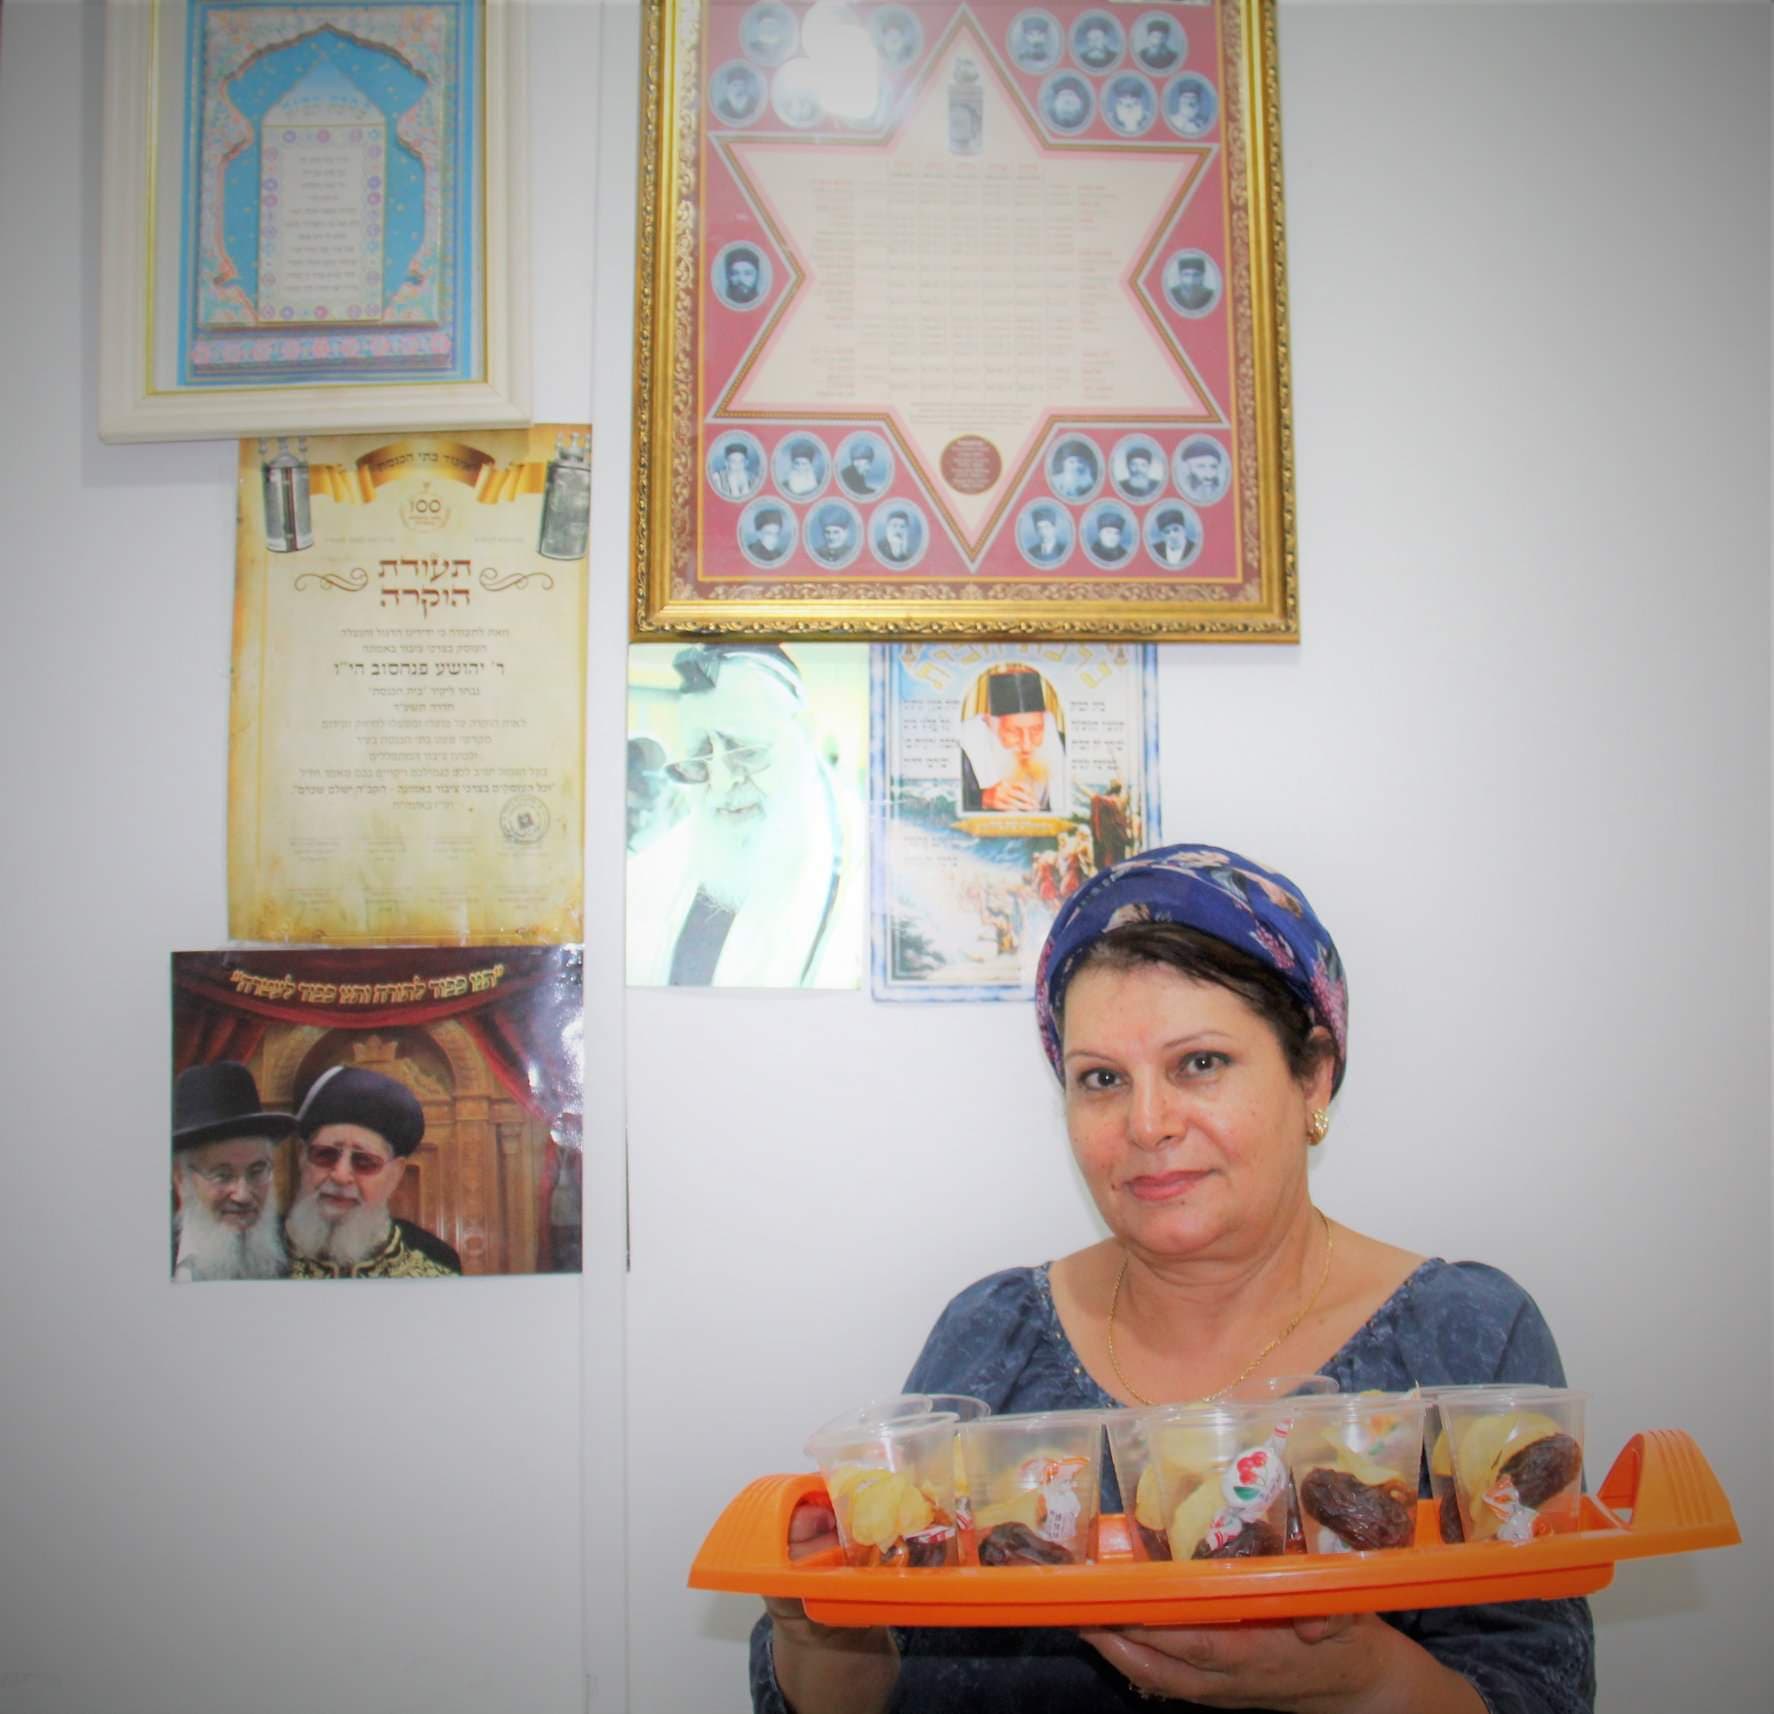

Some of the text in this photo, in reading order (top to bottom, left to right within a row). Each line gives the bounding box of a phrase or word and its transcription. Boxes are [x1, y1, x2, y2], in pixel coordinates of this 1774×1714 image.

[418, 452, 439, 463] בתי
[409, 499, 441, 513] 100
[378, 556, 471, 583] תעודת
[381, 588, 470, 619] הוקרה
[435, 662, 484, 677] יהושע
[492, 660, 505, 676] ר'
